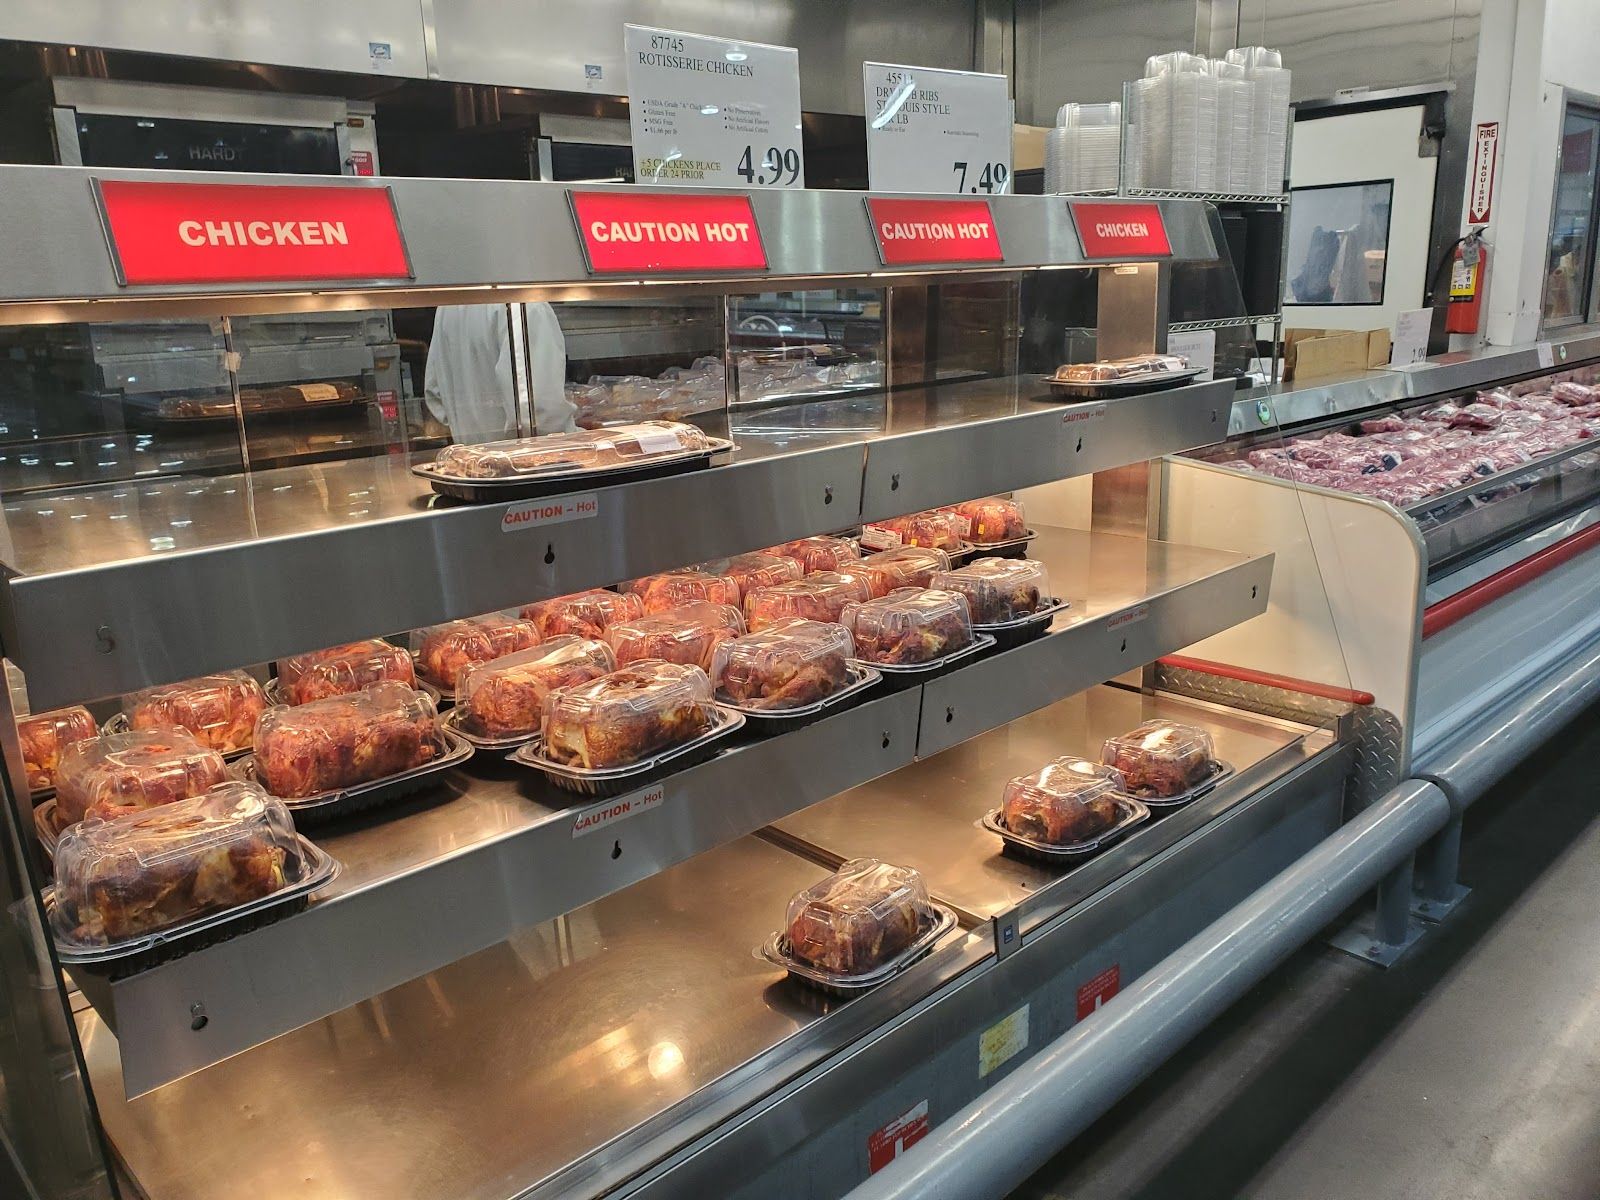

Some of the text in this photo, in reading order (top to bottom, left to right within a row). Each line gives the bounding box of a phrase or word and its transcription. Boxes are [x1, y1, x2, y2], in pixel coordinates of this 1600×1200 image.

[651, 36, 684, 52] 87745
[638, 52, 754, 77] ROTISSERIE CHICKEN
[920, 90, 939, 102] RIBS
[899, 101, 920, 113] OUIS
[922, 103, 951, 115] STYLE
[897, 114, 909, 125] LB
[1479, 129, 1496, 139] FIRE
[669, 169, 679, 178] 24
[680, 170, 705, 180] PRIOR
[695, 161, 721, 171] PLACE
[737, 145, 800, 186] 4.99
[953, 162, 1007, 194] 7.49
[1477, 141, 1490, 213] EXTINGUISHER
[178, 220, 349, 246] CHICKEN
[591, 221, 749, 242] CAUTION HOT
[881, 222, 989, 240] CAUTION HOT
[1095, 222, 1149, 238] CHICKEN
[504, 505, 563, 524] CAUTION
[576, 501, 596, 513] Hot
[575, 802, 631, 831] CAUTION
[643, 791, 662, 805] Hot
